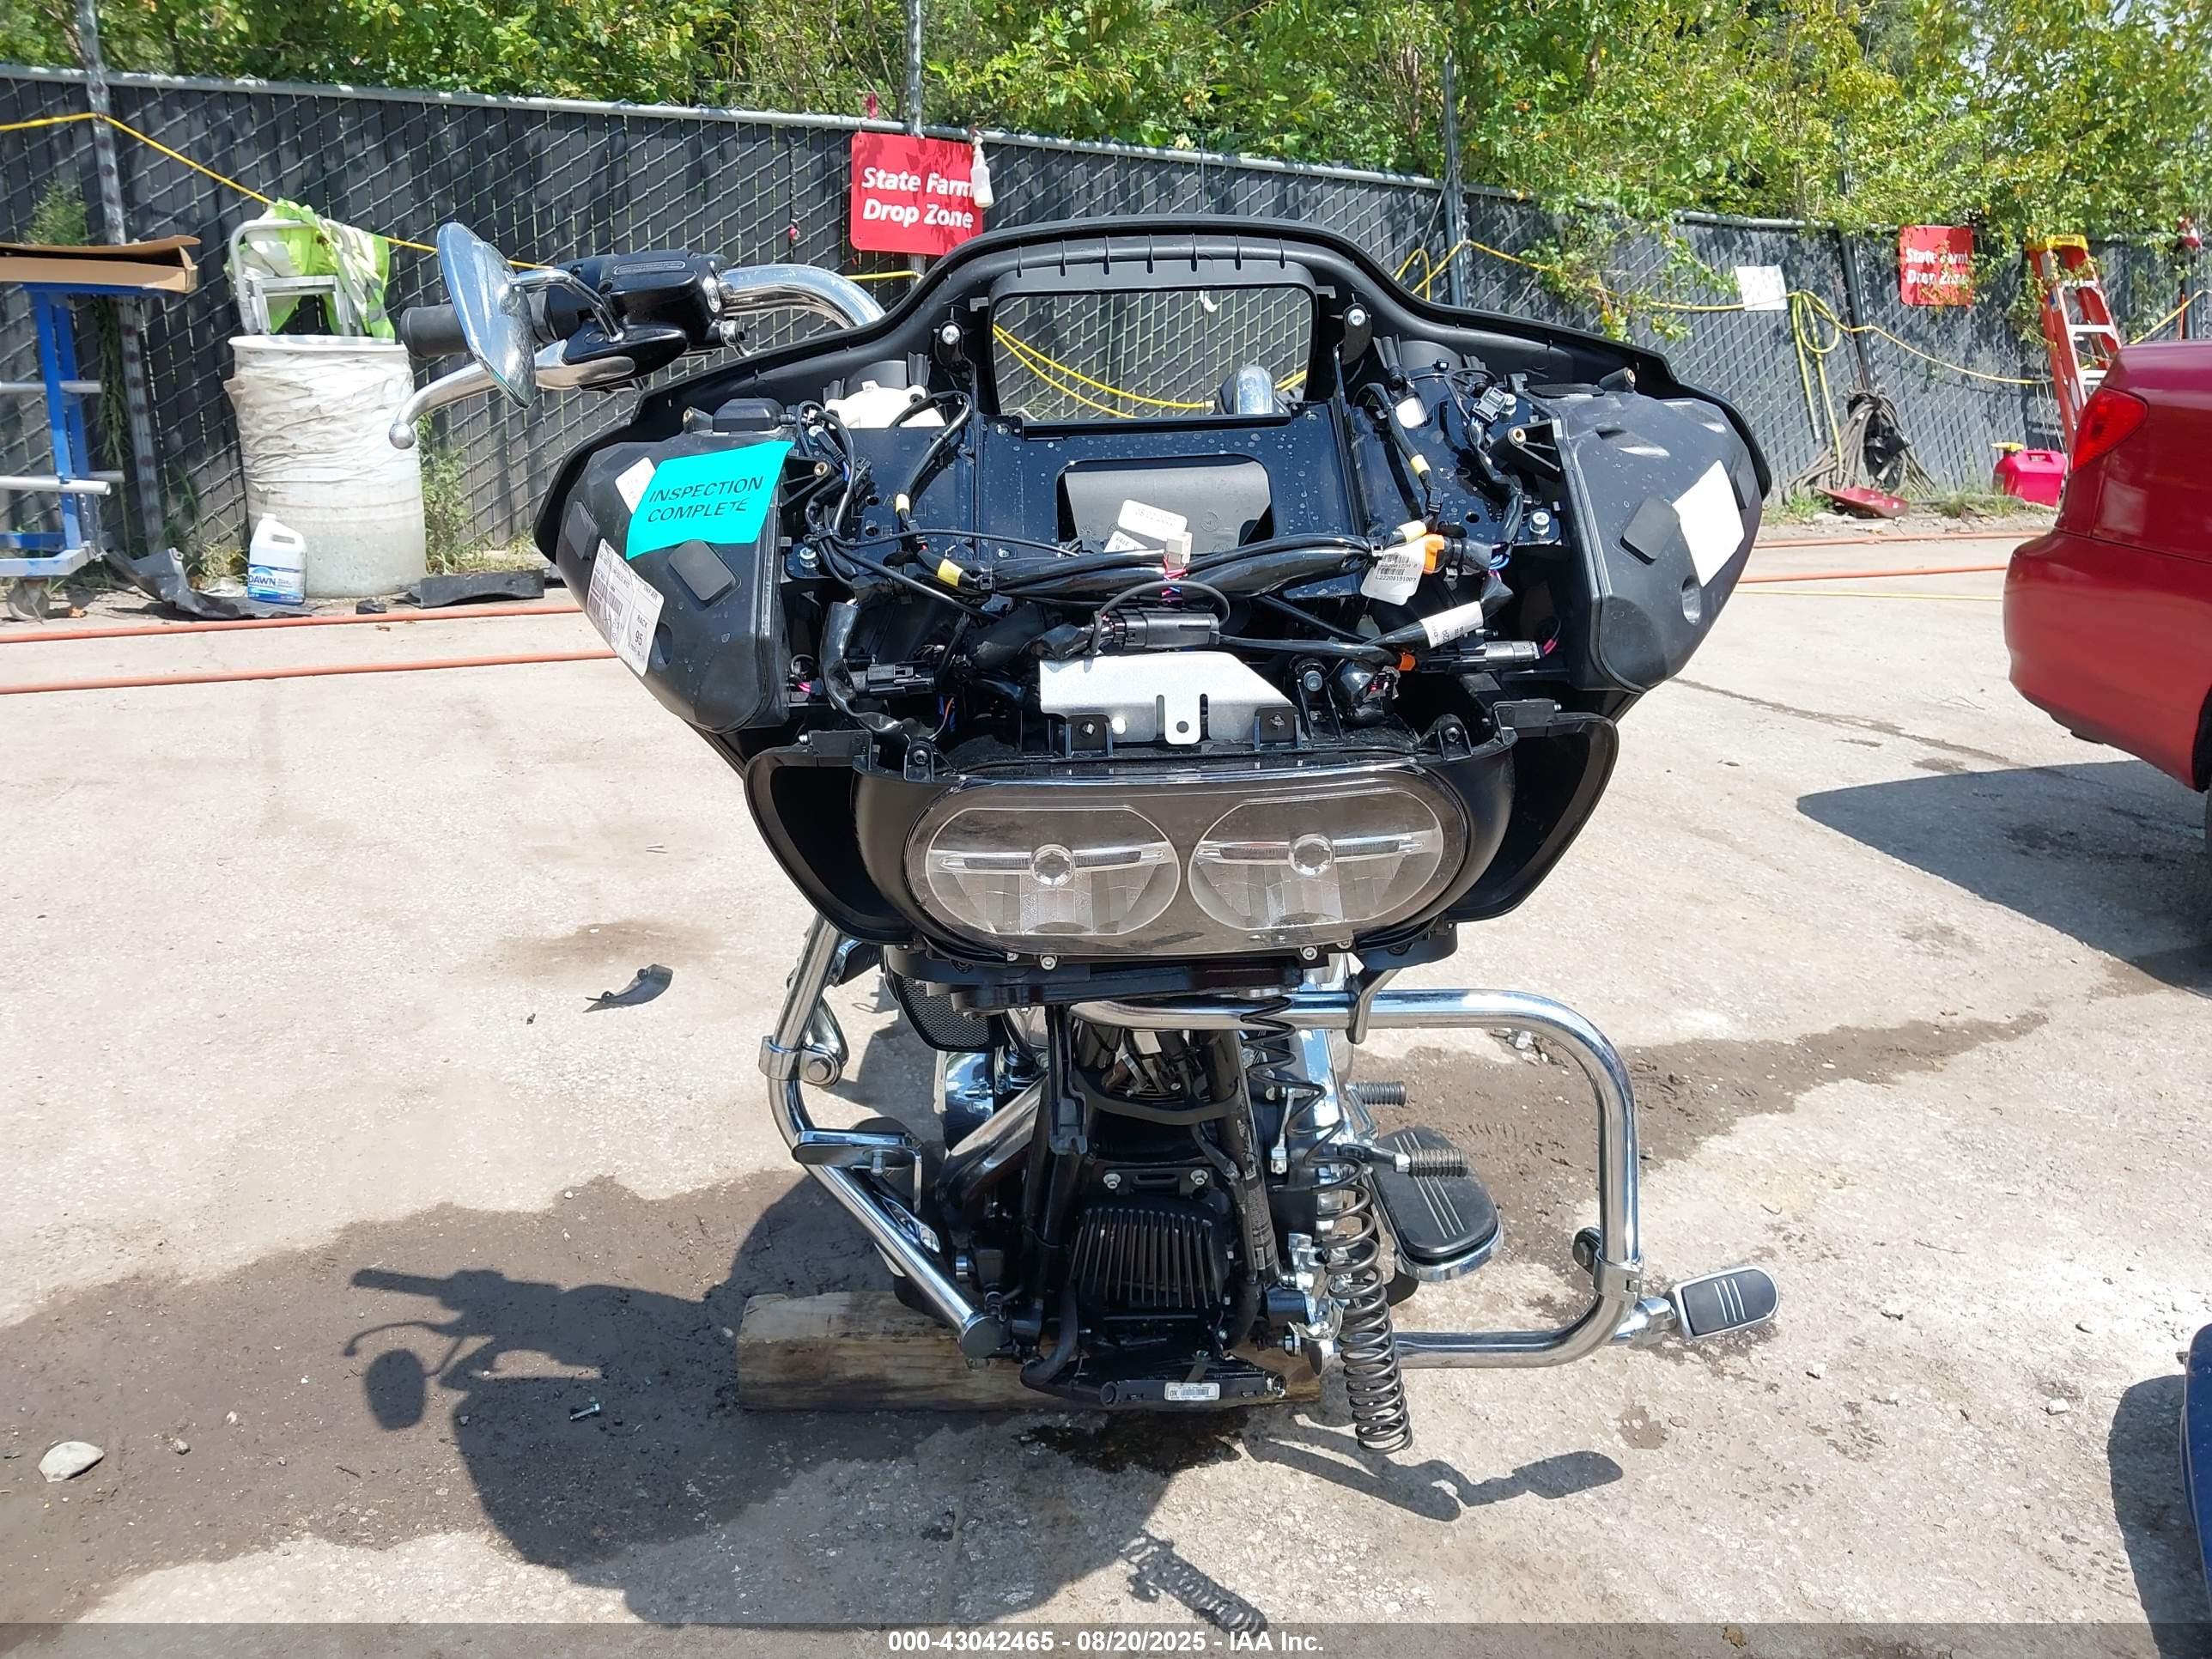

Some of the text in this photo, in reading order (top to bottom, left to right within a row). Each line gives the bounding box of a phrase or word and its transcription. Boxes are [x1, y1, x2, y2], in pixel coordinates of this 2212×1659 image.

[861, 167, 973, 198] State Farm
[862, 198, 974, 228] Drop Zone
[1905, 247, 1968, 264] State arm
[648, 477, 763, 503] INSPECTION
[647, 498, 750, 523] COMPLETE
[248, 574, 276, 586] DAWN
[635, 630, 644, 646] 95
